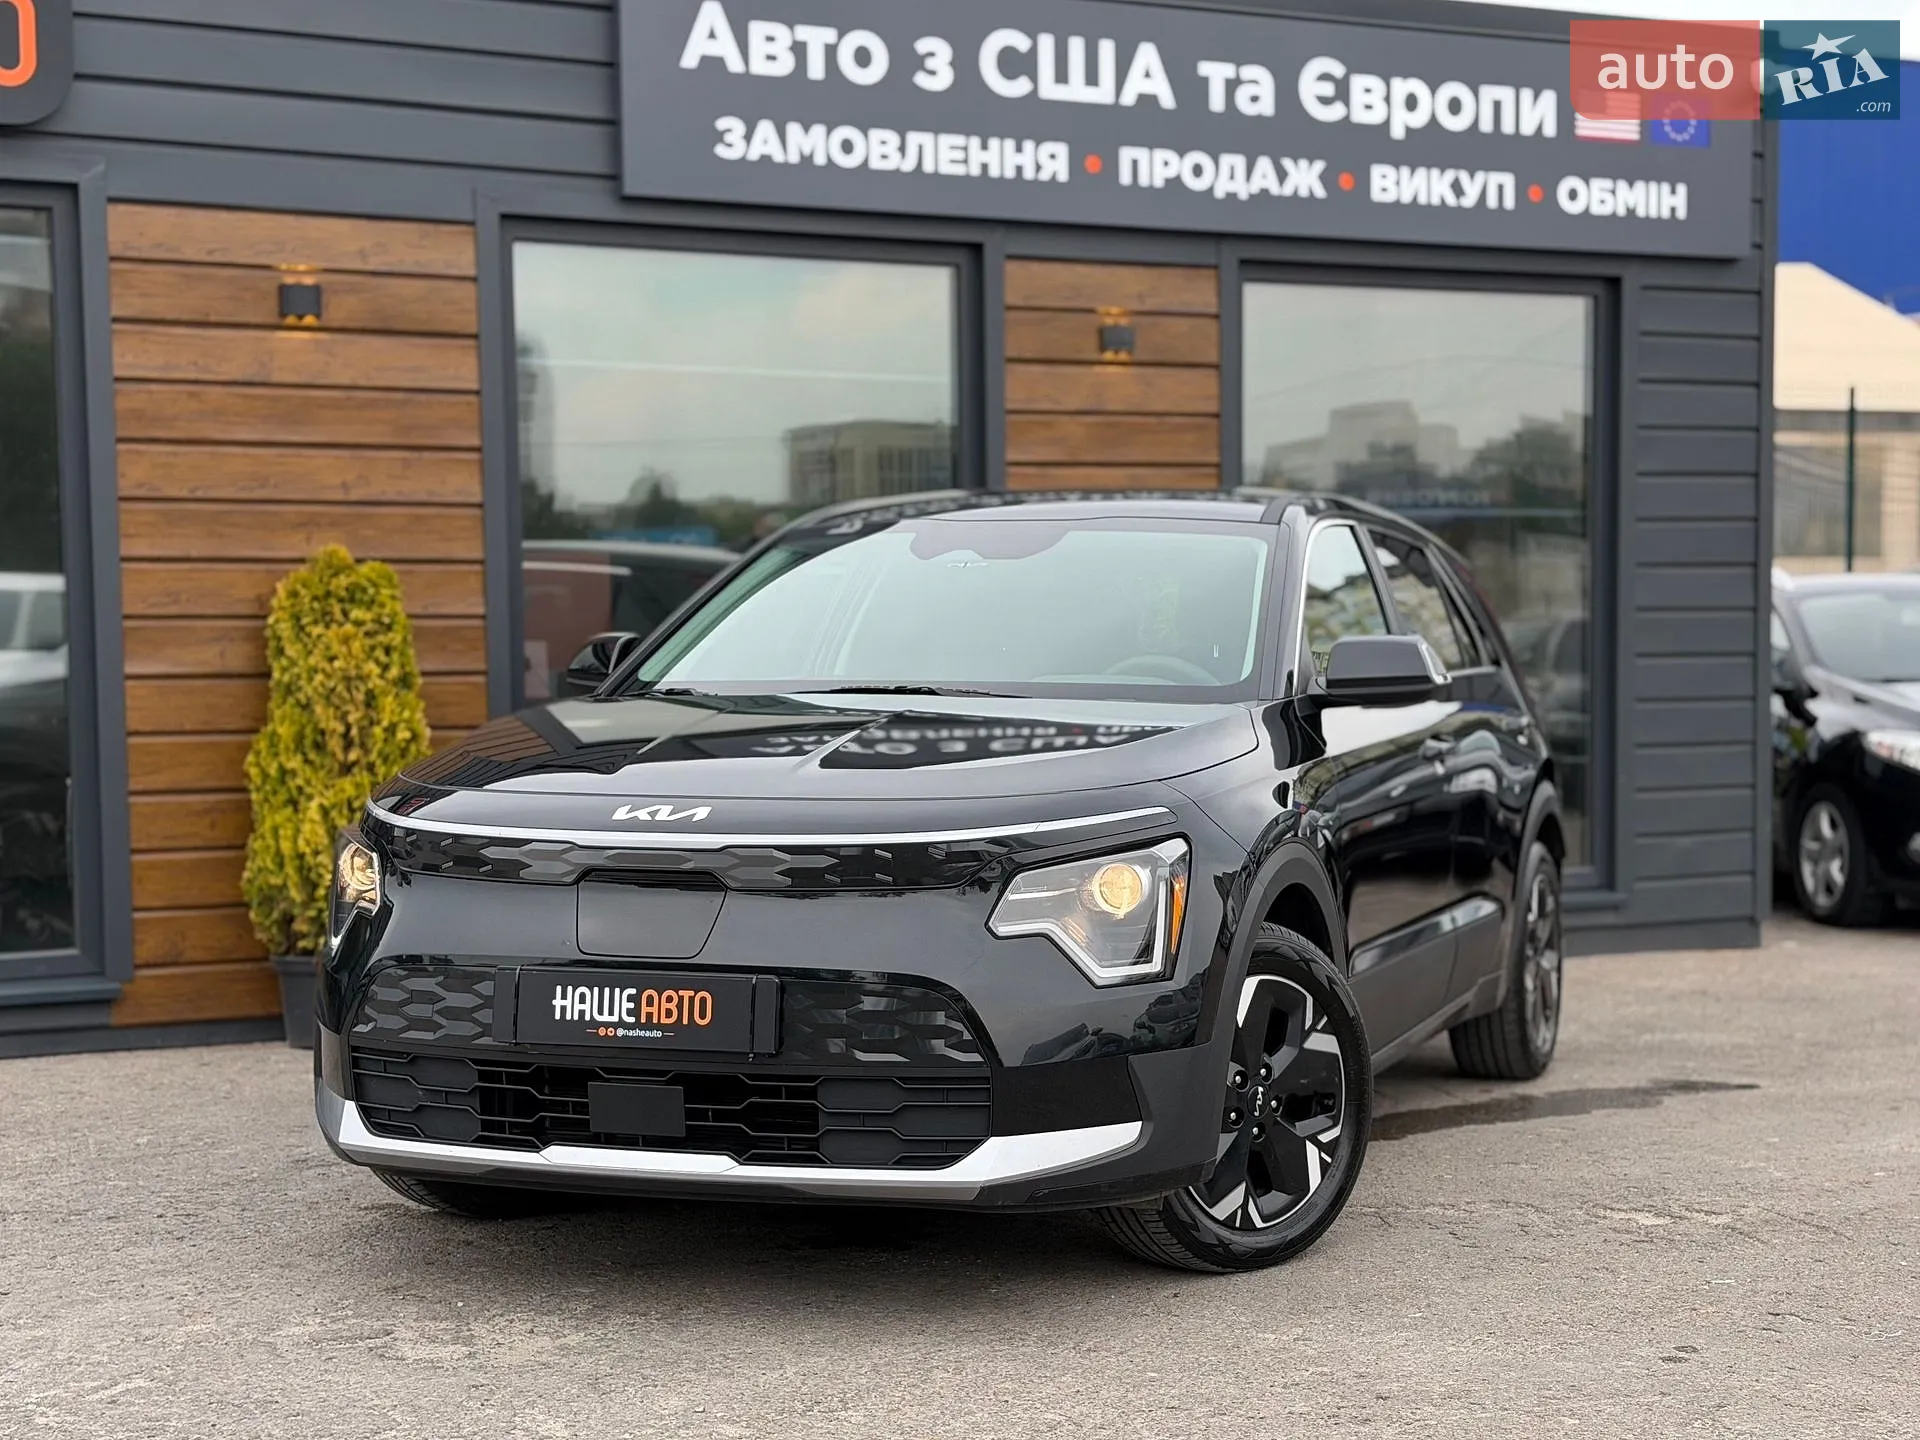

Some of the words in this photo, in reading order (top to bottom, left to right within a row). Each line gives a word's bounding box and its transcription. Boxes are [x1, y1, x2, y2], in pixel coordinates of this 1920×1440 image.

[679, 0, 890, 85] Авто
[978, 28, 1177, 110] США
[1197, 60, 1276, 117] та
[1296, 56, 1558, 140] Європи
[713, 115, 1070, 183] ЗАМОВЛЕННЯ
[1118, 145, 1327, 201] ПРОДАЖ
[1369, 163, 1516, 211] ВИКУП
[1556, 175, 1688, 220] ОБМІН
[611, 804, 713, 822] KIA
[552, 985, 637, 1024] НАШЕ
[640, 989, 713, 1026] АВТО
[616, 1027, 663, 1038] @nasheauto
